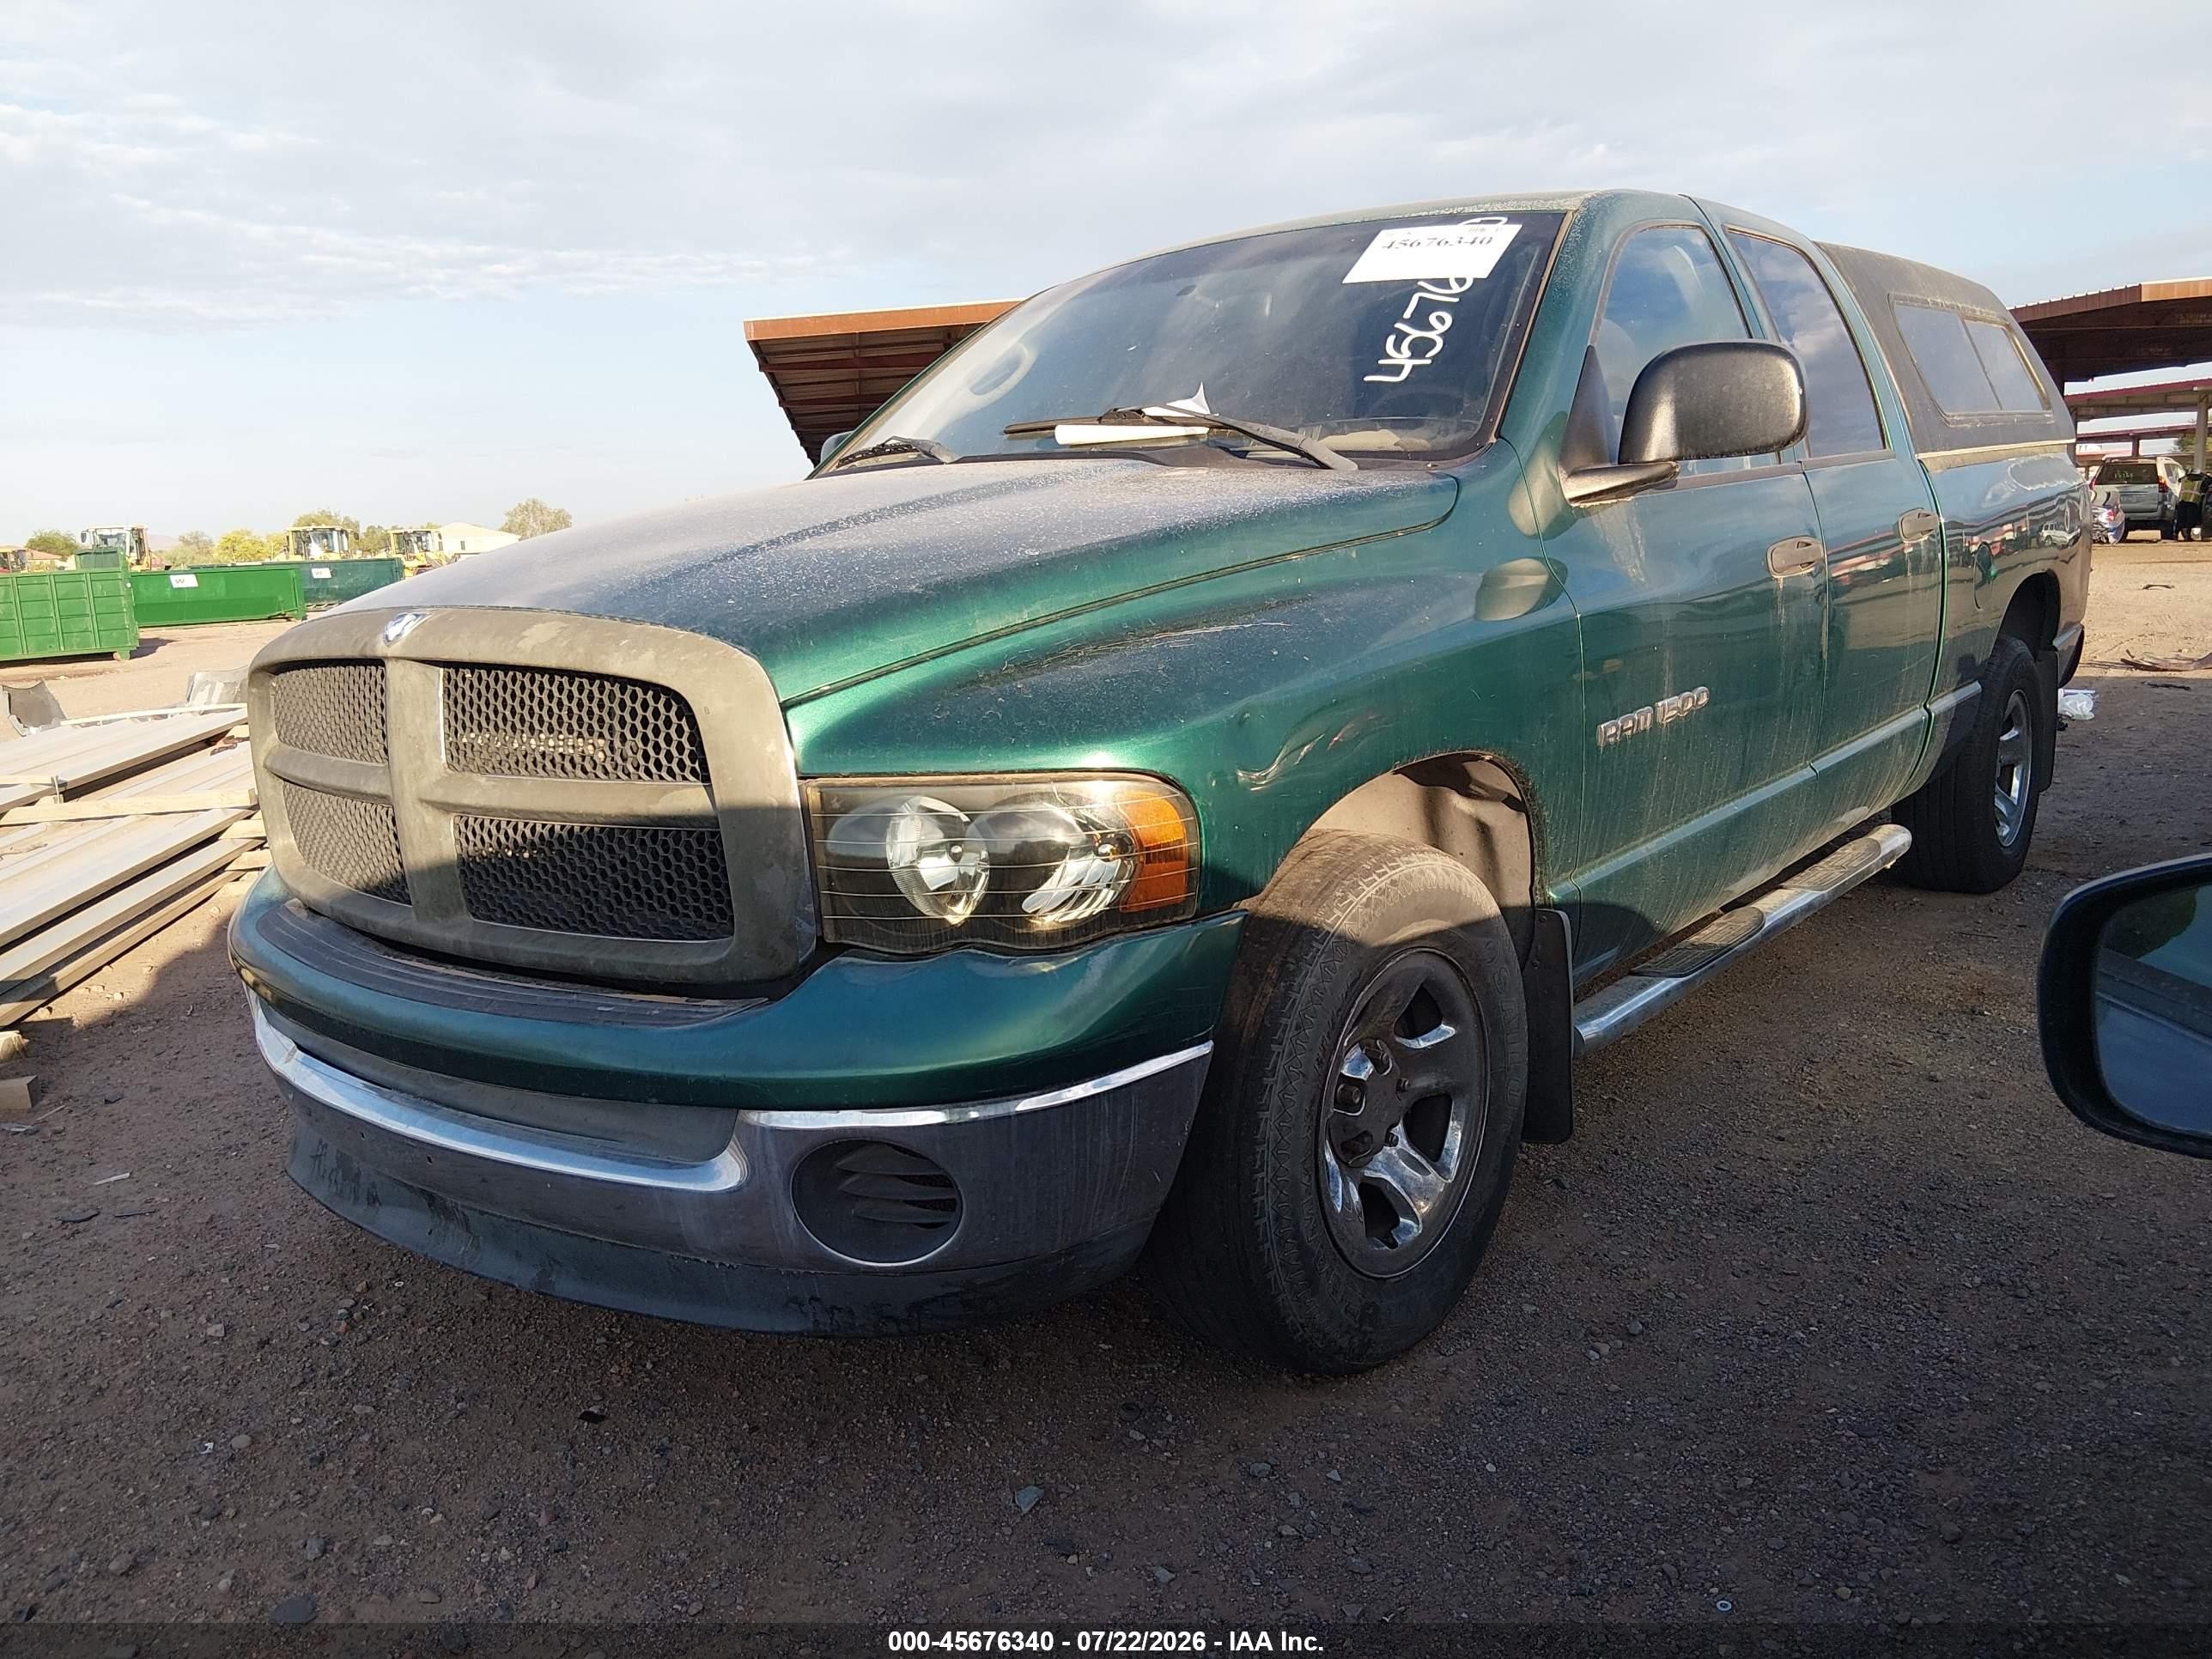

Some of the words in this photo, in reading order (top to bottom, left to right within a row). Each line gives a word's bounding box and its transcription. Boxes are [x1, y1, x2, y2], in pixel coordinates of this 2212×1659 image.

[1381, 235, 1494, 251] 45676340
[1596, 706, 1654, 747] RAM
[1655, 686, 1711, 725] 1500
